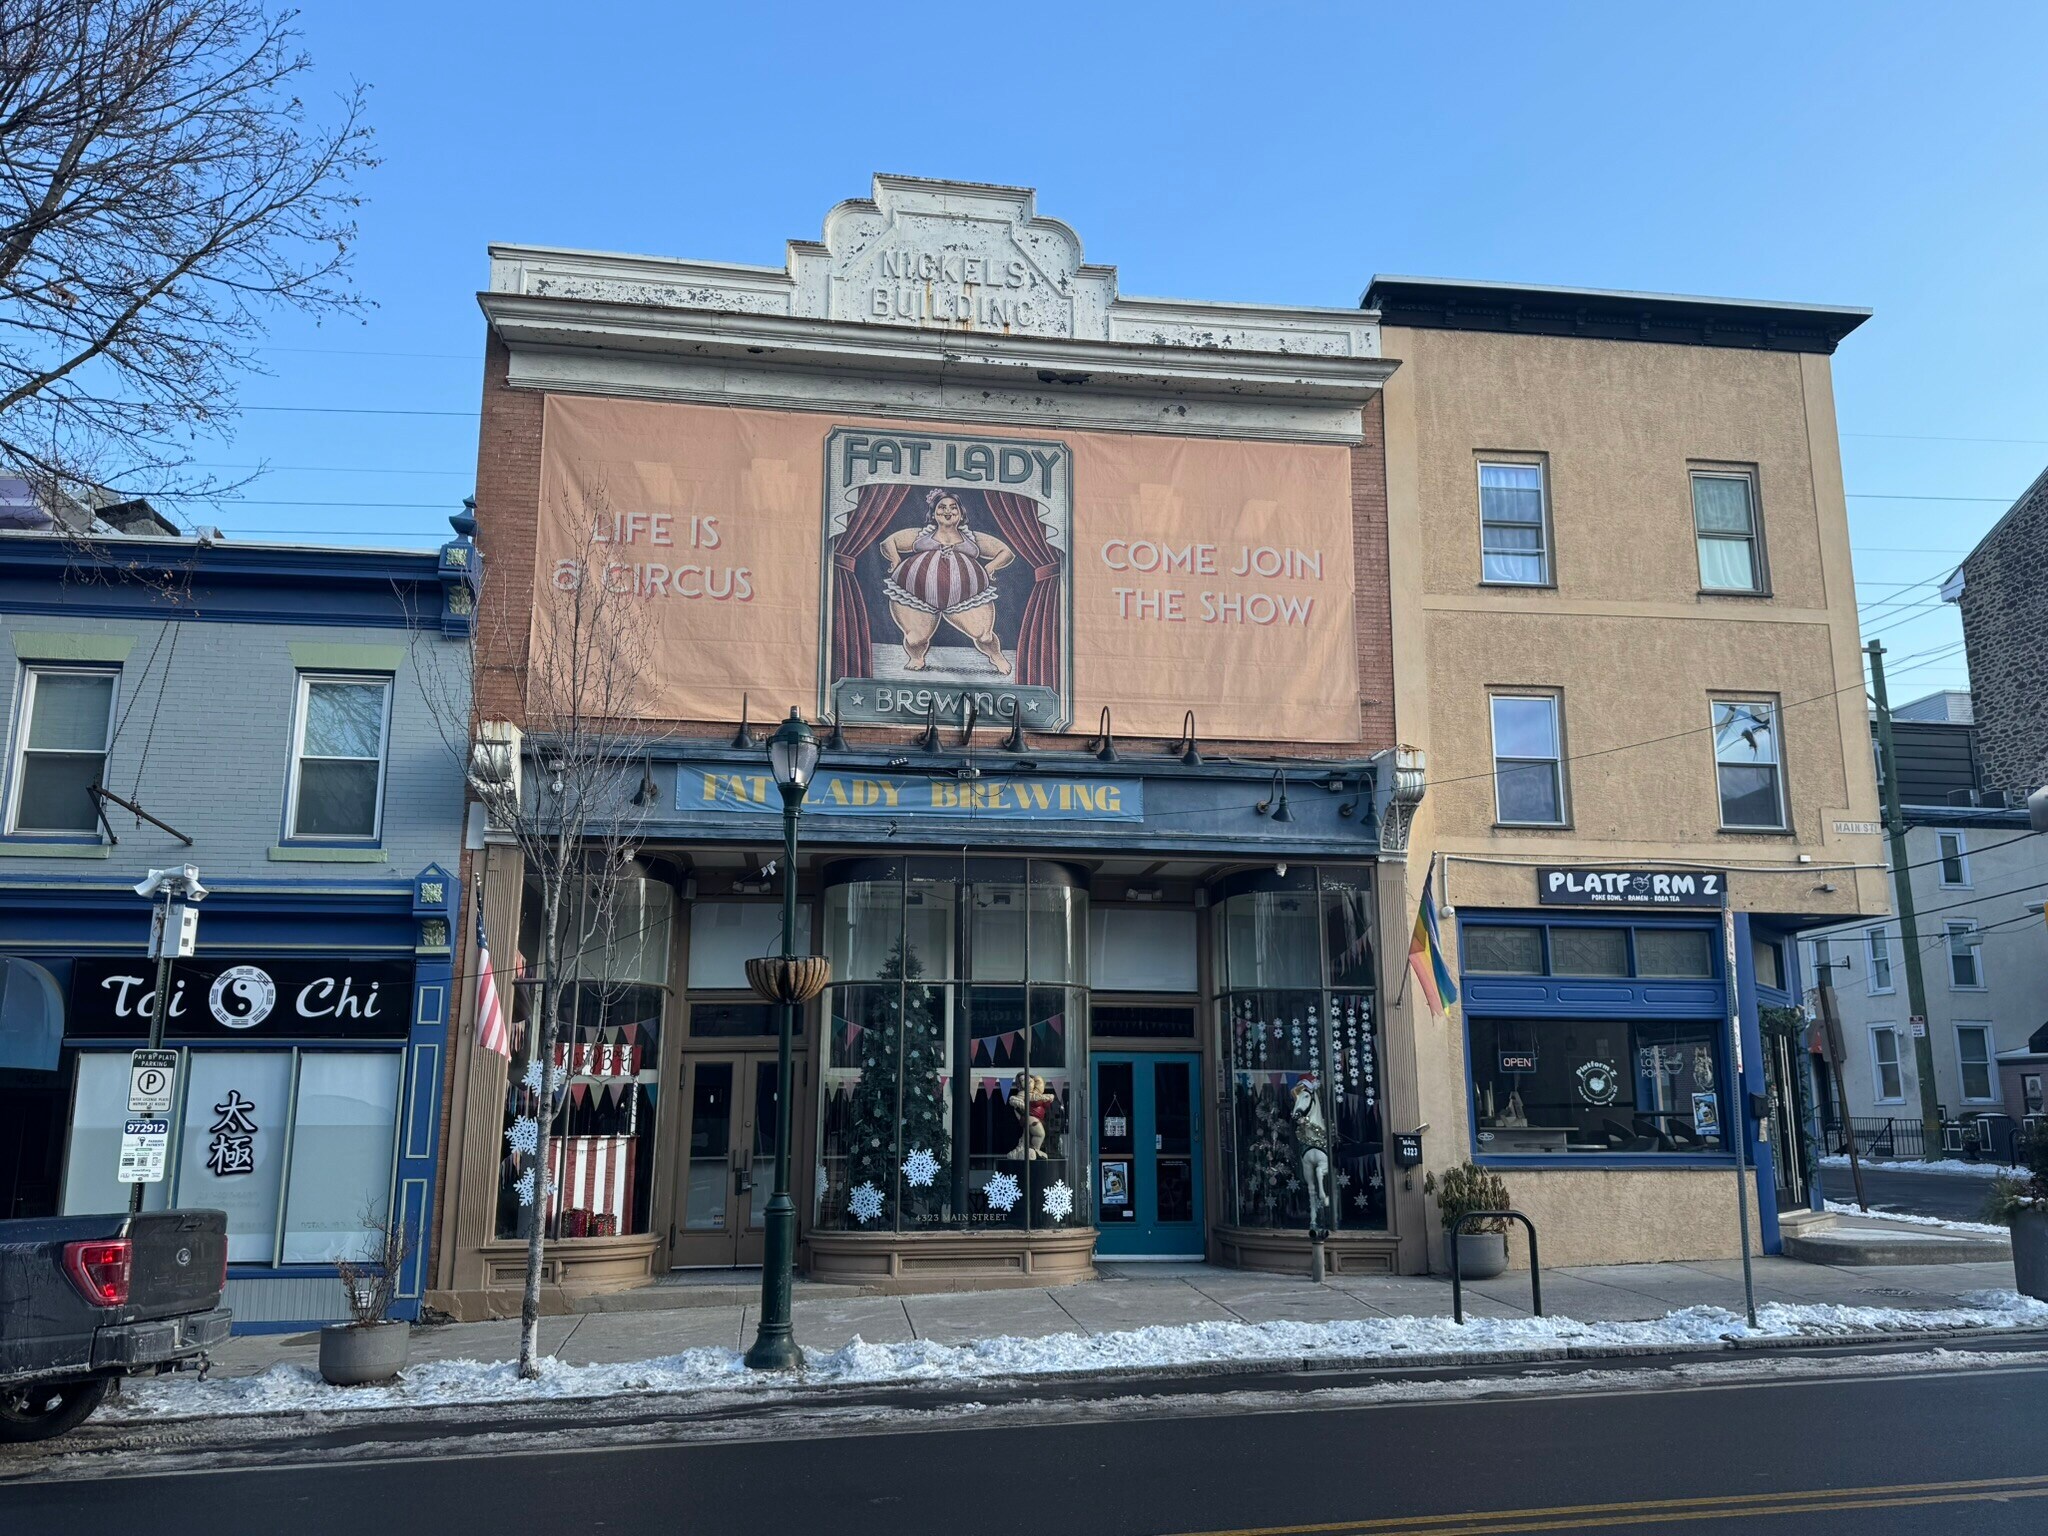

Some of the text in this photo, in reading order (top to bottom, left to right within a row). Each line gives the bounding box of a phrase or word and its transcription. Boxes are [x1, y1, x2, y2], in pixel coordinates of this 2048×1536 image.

[882, 250, 1027, 288] NICKELS
[872, 287, 1034, 326] BUILDING
[843, 437, 1061, 498] FAT LADY
[592, 511, 721, 549] LIFE IS
[1101, 539, 1323, 581] COME JOIN
[603, 562, 754, 601] CIRCUS
[1112, 587, 1314, 627] THE SHOW
[703, 773, 774, 802] FAT
[931, 781, 1120, 811] BREWING
[1835, 822, 1860, 832] MAIN
[296, 976, 381, 1018] Chi
[1503, 1057, 1532, 1067] OPEN
[1576, 1060, 1610, 1079] Platform
[1640, 1047, 1667, 1056] PEACE
[127, 1123, 166, 1133] 972912
[207, 1090, 258, 1176] 太極
[1403, 1147, 1418, 1156] 4323
[916, 1213, 1008, 1222] 4323 MAIN STREET
